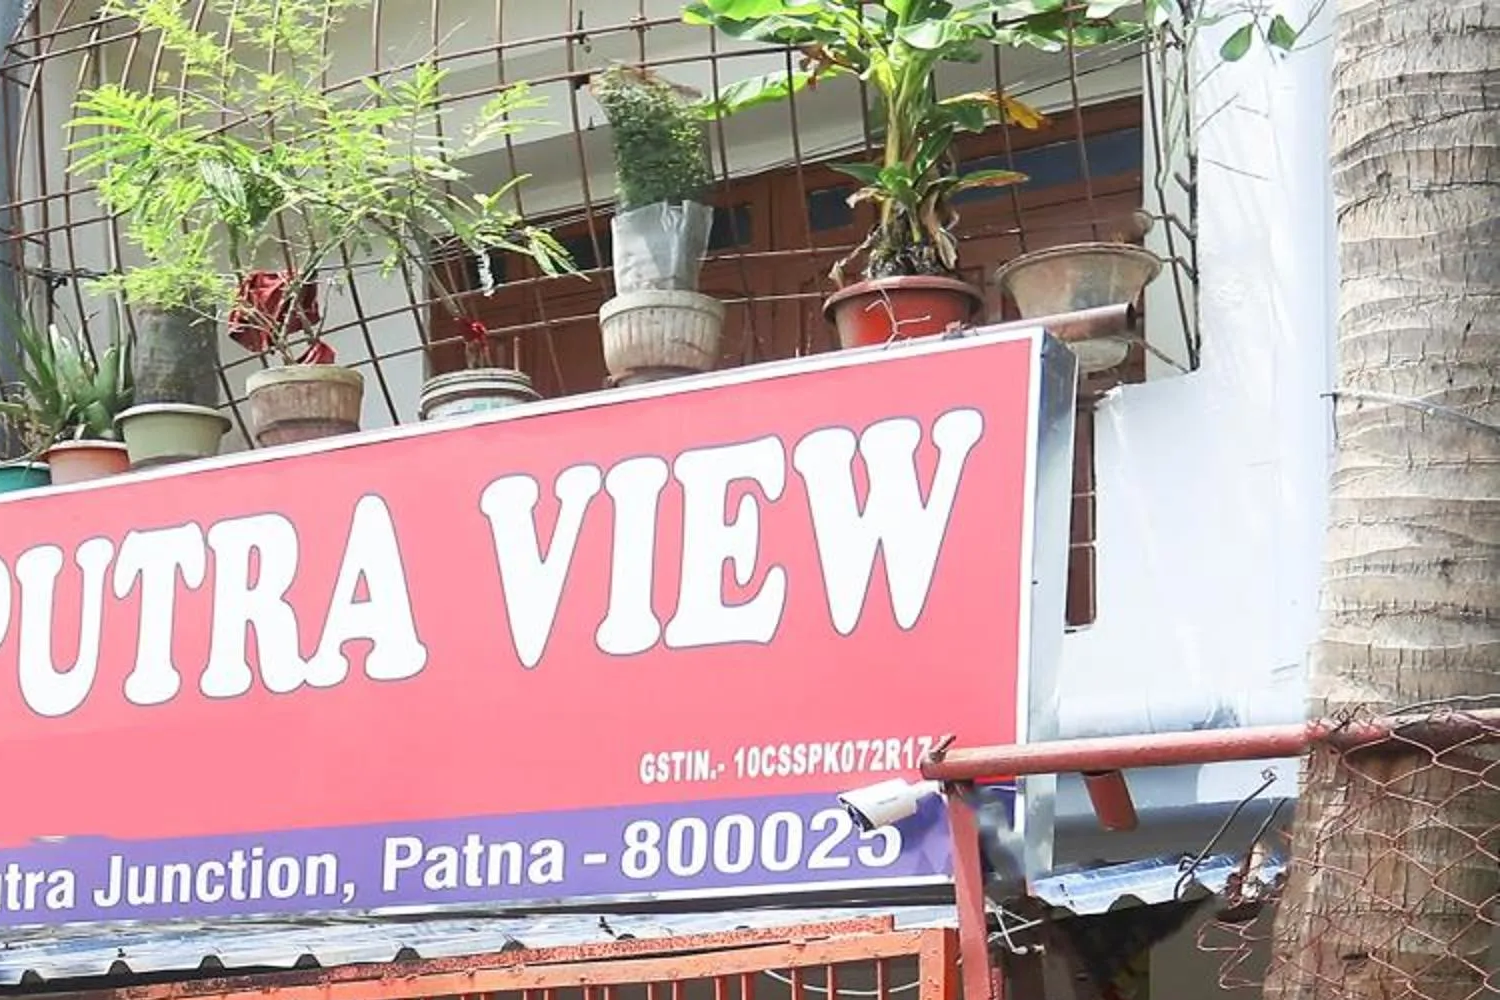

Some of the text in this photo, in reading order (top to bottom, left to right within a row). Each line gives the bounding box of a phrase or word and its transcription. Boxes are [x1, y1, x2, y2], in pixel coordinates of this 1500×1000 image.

[480, 407, 985, 670] VIEW
[94, 846, 356, 908] Junction,
[382, 833, 567, 893] Patna
[620, 808, 903, 880] 800025
